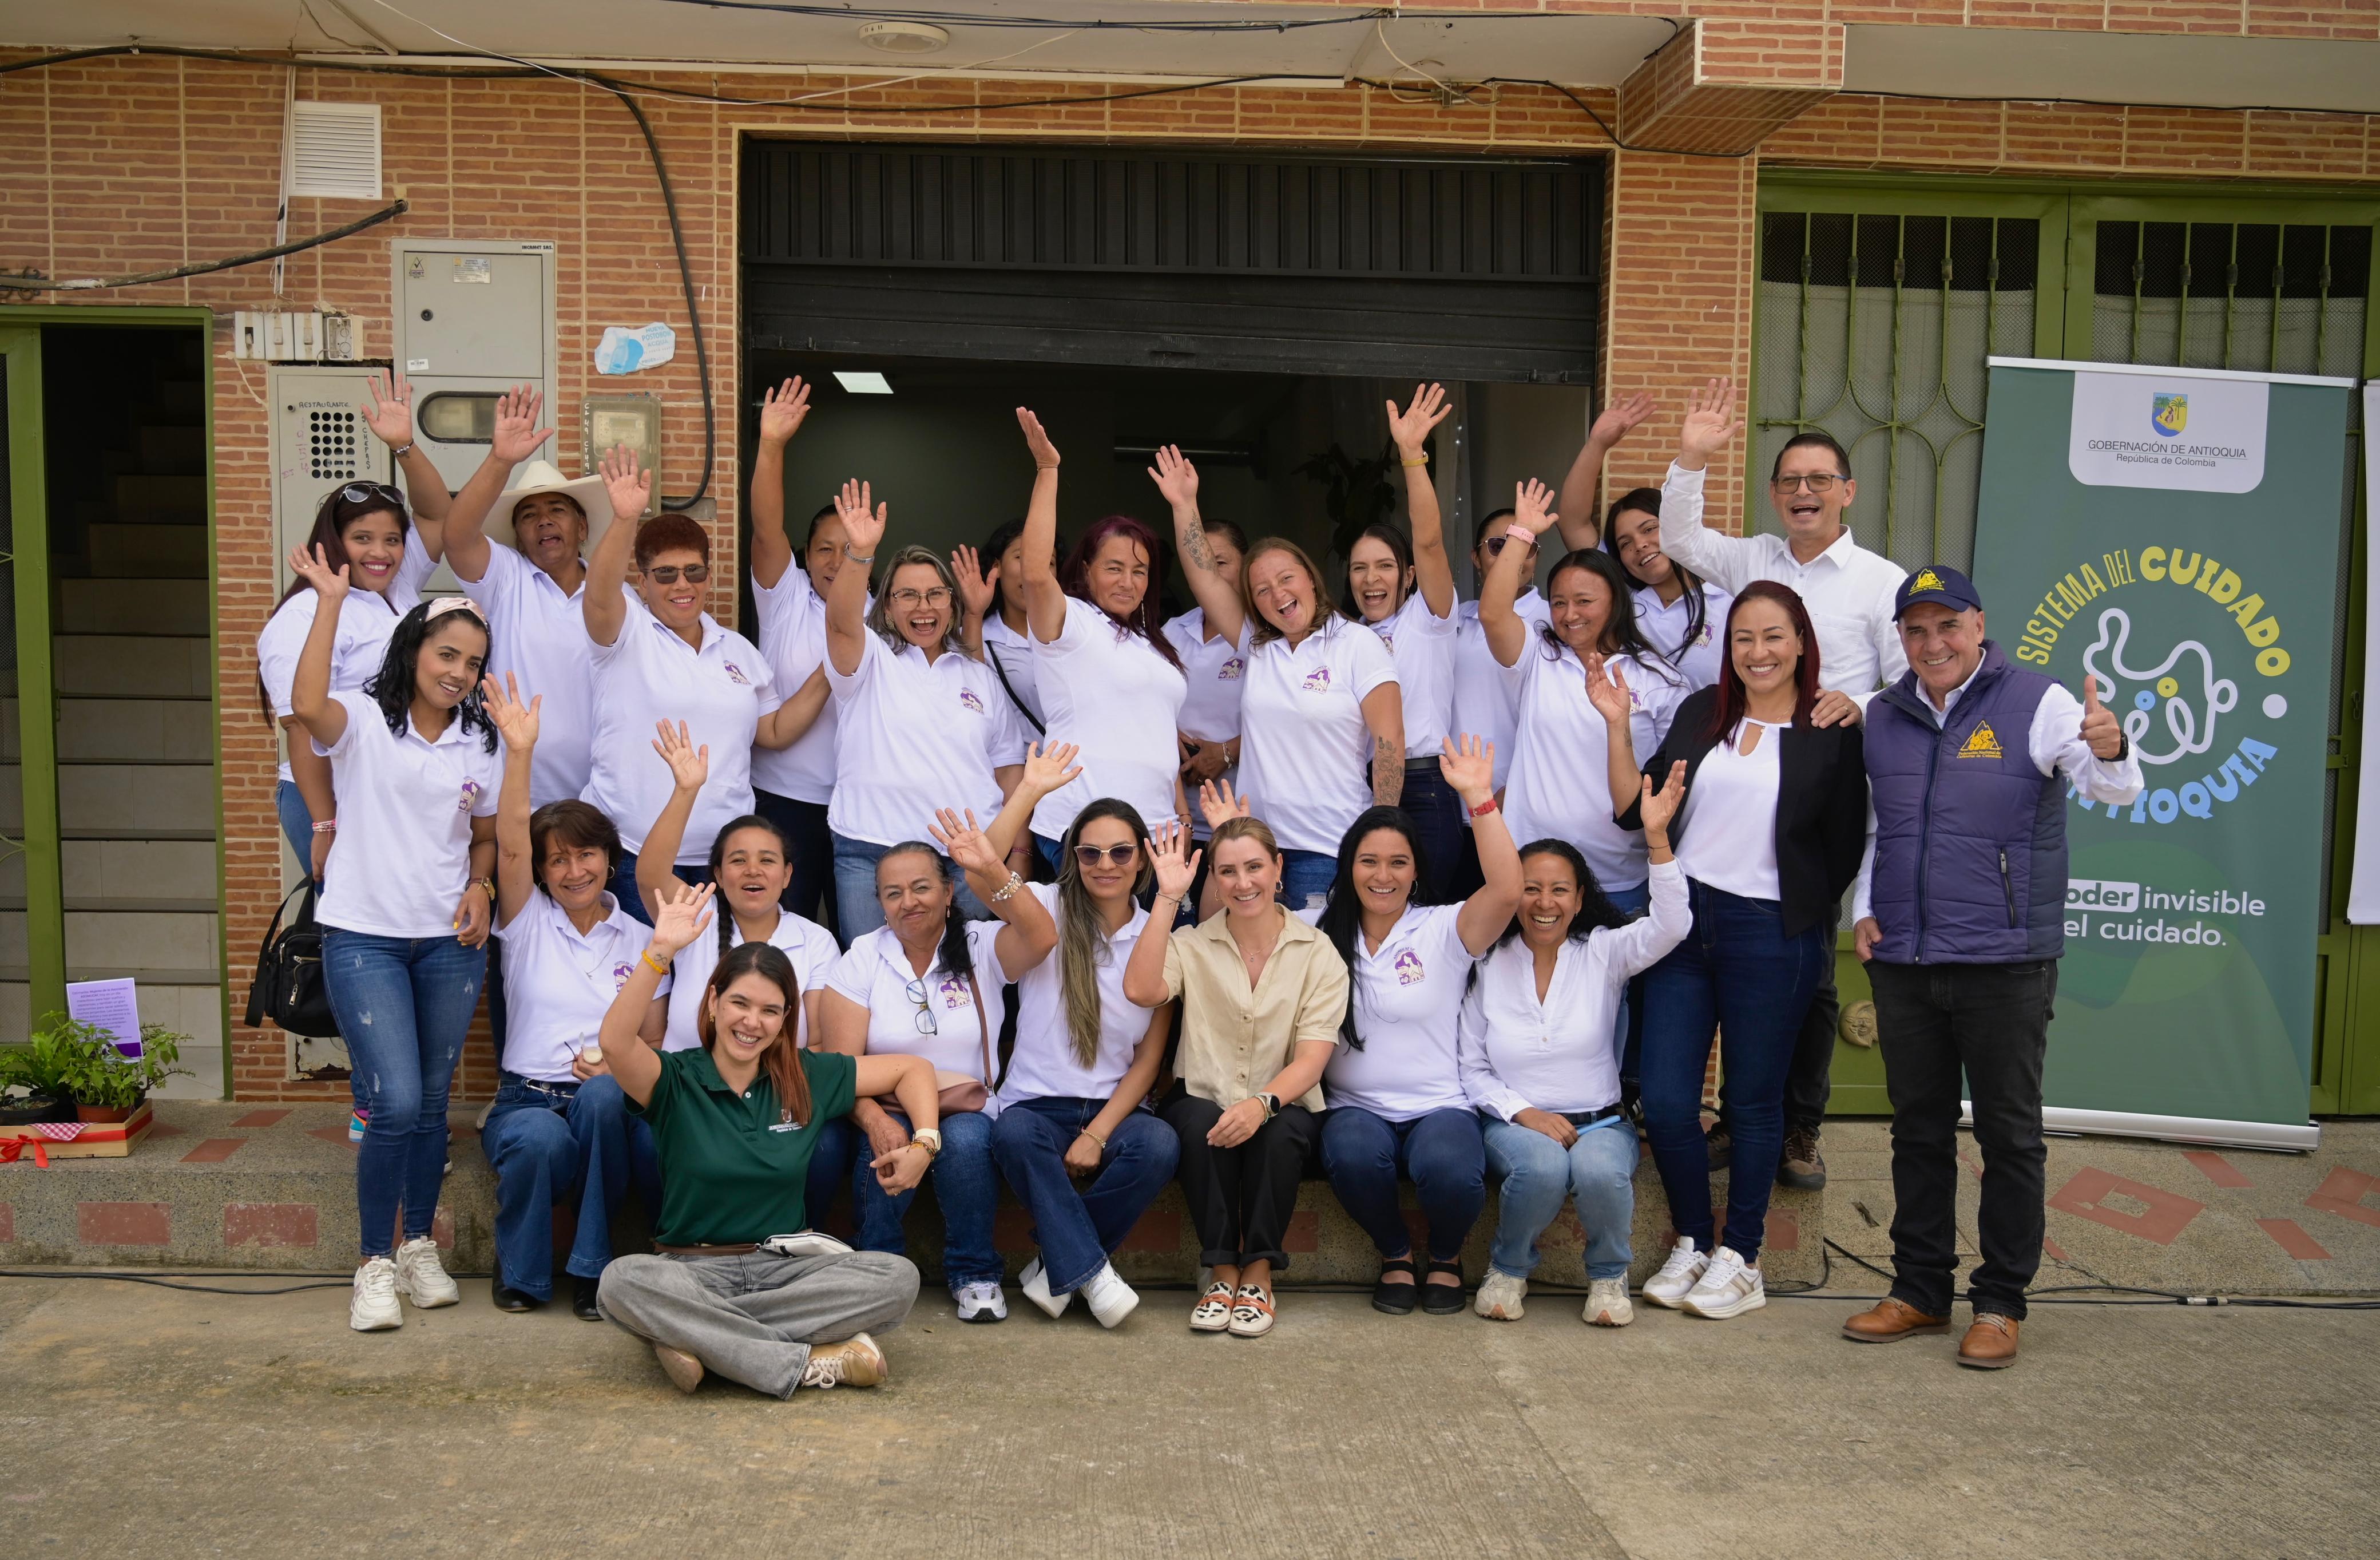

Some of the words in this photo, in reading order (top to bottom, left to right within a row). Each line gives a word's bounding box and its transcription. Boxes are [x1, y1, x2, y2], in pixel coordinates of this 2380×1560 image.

[647, 339, 669, 347] ACQUA
[2088, 440, 2167, 453] GOBERNACIÓN
[2171, 444, 2186, 454] DE
[2188, 445, 2246, 458] ANTIOQUIA
[2117, 453, 2159, 464] República
[2175, 457, 2216, 467] Colombia
[2017, 563, 2106, 664] SISTEMA
[2103, 549, 2136, 588] DEL
[2140, 547, 2290, 676] CUIDADO
[2065, 882, 2133, 906] oder
[2145, 886, 2265, 916] invisible
[2064, 914, 2088, 937] el
[2100, 918, 2227, 946] cuidado.
